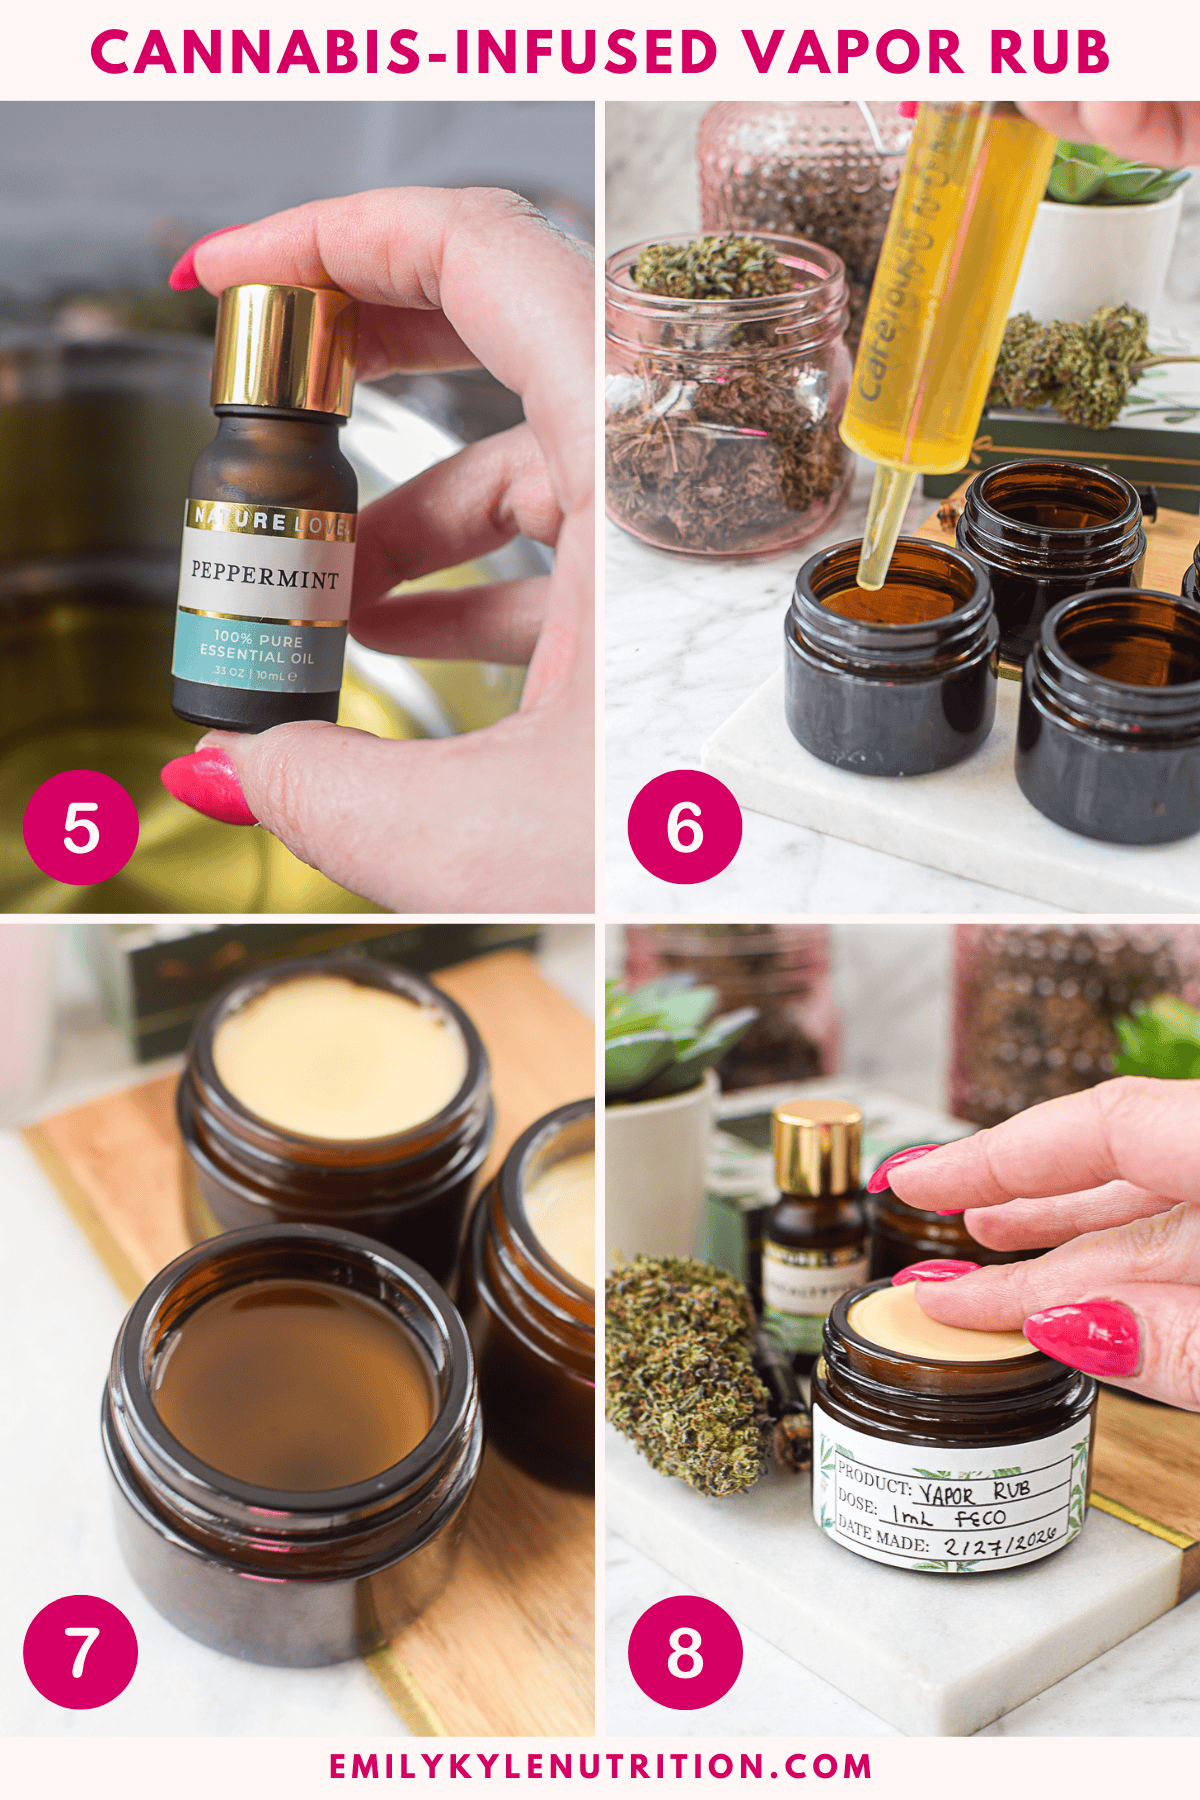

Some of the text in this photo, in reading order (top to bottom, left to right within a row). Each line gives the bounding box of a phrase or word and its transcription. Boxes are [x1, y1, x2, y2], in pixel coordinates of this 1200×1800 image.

[195, 506, 286, 531] NATURE
[191, 559, 340, 590] PEPPERMINT
[214, 629, 303, 648] 100% PURE
[200, 643, 315, 665] ESSENTIAL OIL
[229, 667, 245, 678] OZ
[838, 1459, 912, 1496] PRODUCT:
[838, 1487, 878, 1516] DOSE:
[919, 1480, 1031, 1506] VAPOR RUB
[893, 1504, 1007, 1528] 1mL FECO
[838, 1513, 930, 1553] DATE MADE:
